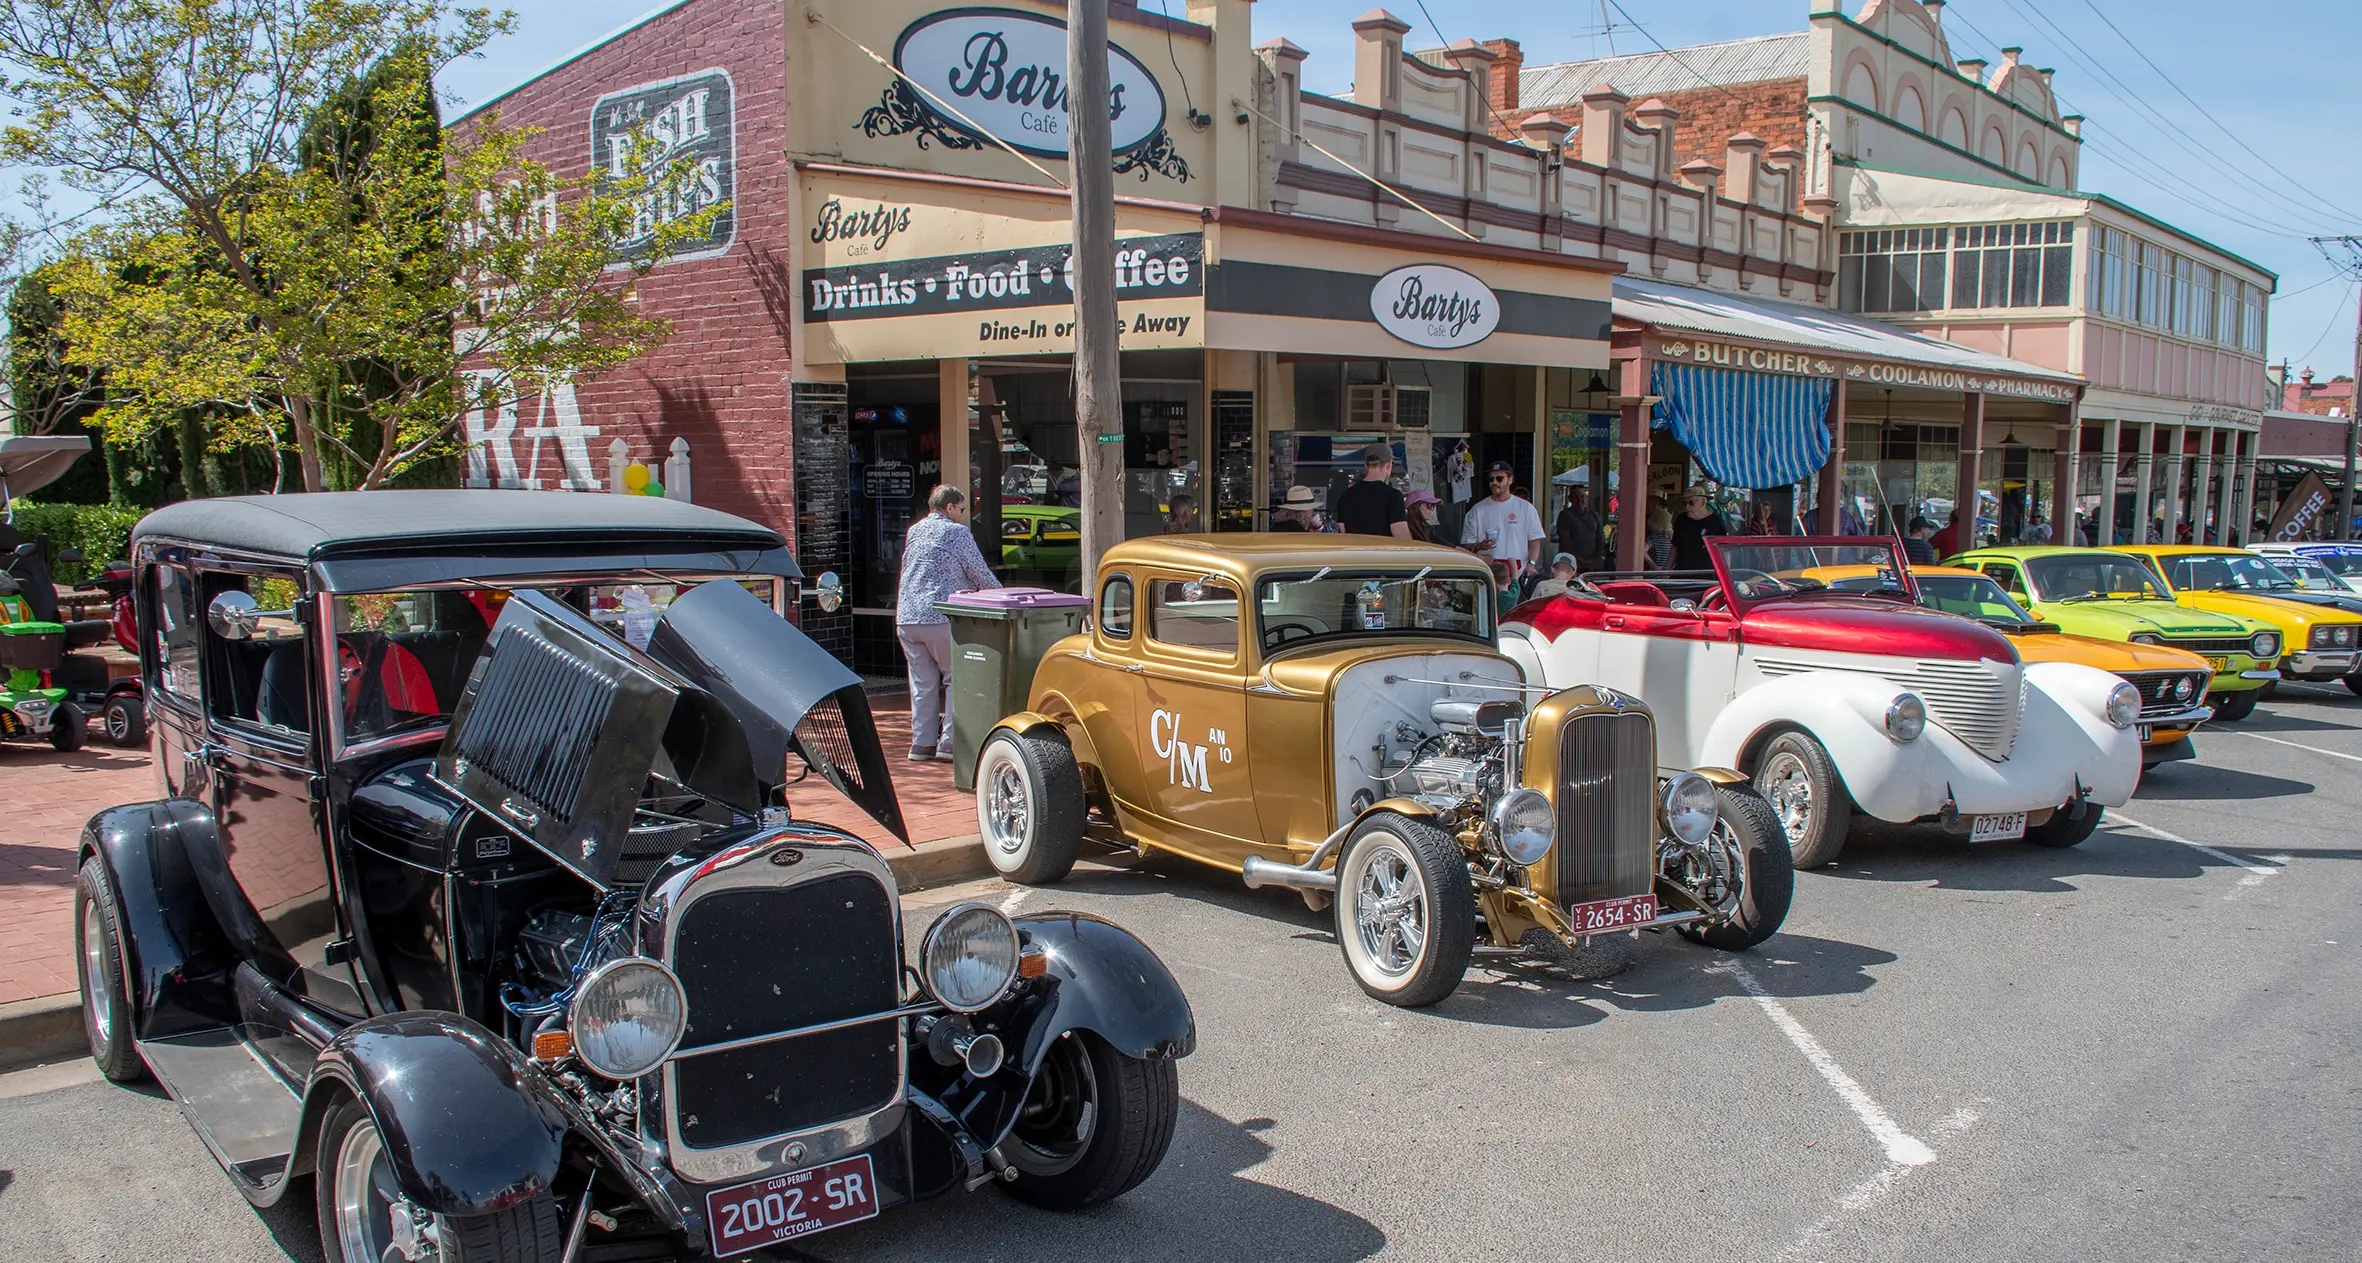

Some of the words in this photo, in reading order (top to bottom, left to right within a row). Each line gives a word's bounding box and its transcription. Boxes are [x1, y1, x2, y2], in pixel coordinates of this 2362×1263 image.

[605, 88, 710, 182] FSH
[1021, 112, 1057, 134] Café
[811, 198, 911, 251] Bartys
[847, 243, 869, 257] Café
[811, 272, 918, 311] Drinks
[946, 262, 1031, 300] Food
[1393, 275, 1482, 338] Bartys
[979, 319, 1048, 341] Dine-In
[1132, 313, 1191, 336] Away
[1427, 323, 1446, 338] Café
[1693, 340, 1811, 375] BUTCHER
[1869, 363, 1966, 391] COOLAMON
[1998, 378, 2064, 400] PHARMACY
[1574, 424, 1608, 438] Coolamon
[2275, 490, 2326, 542] COFFEE
[774, 851, 800, 863] Ford
[767, 1180, 787, 1191] CLUB
[787, 1171, 813, 1187] PERMIT
[773, 1217, 823, 1239] VICTORIA
